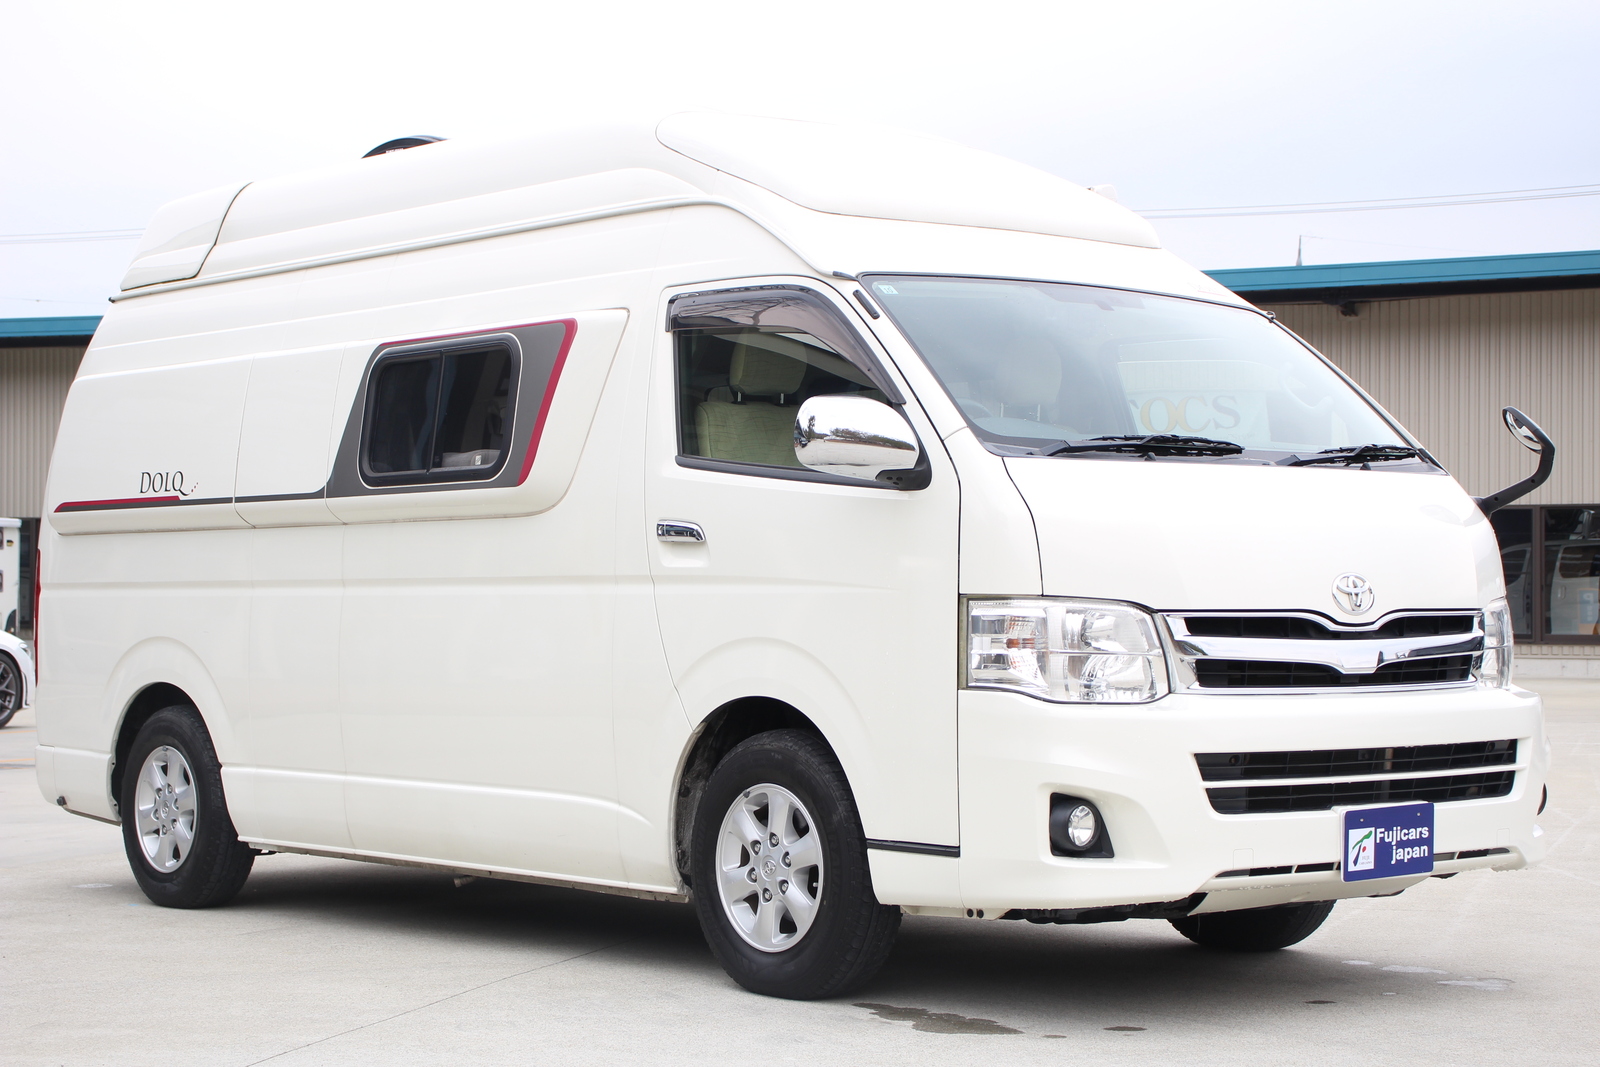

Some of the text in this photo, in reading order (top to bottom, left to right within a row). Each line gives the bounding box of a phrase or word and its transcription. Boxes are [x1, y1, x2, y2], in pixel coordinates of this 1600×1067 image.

[1129, 395, 1241, 434] OCS
[139, 470, 190, 496] DOLQ
[1376, 826, 1429, 845] Fujicars
[1391, 845, 1428, 864] japan
